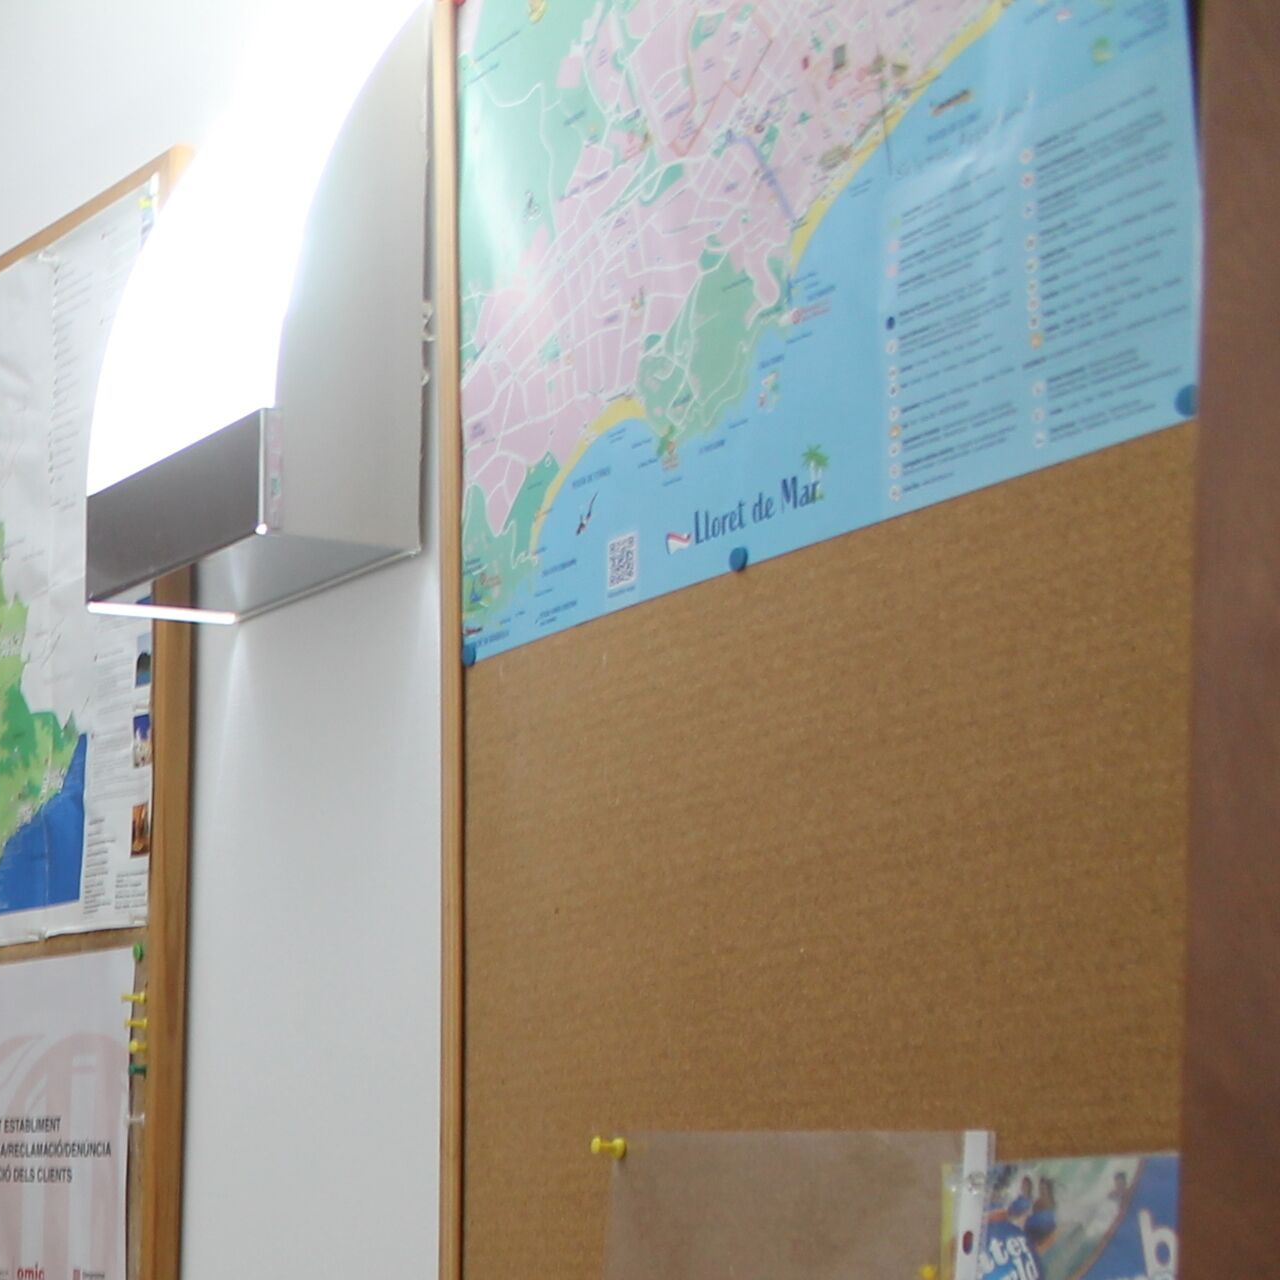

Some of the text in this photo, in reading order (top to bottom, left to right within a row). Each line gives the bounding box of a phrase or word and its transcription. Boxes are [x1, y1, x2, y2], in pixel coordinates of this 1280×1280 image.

[694, 475, 820, 545] Lloret de Mar
[3, 1117, 61, 1134] ESTABLIMENT
[13, 1167, 35, 1183] DELS
[36, 1166, 73, 1184] CLIENTS
[978, 1235, 1028, 1274] ter
